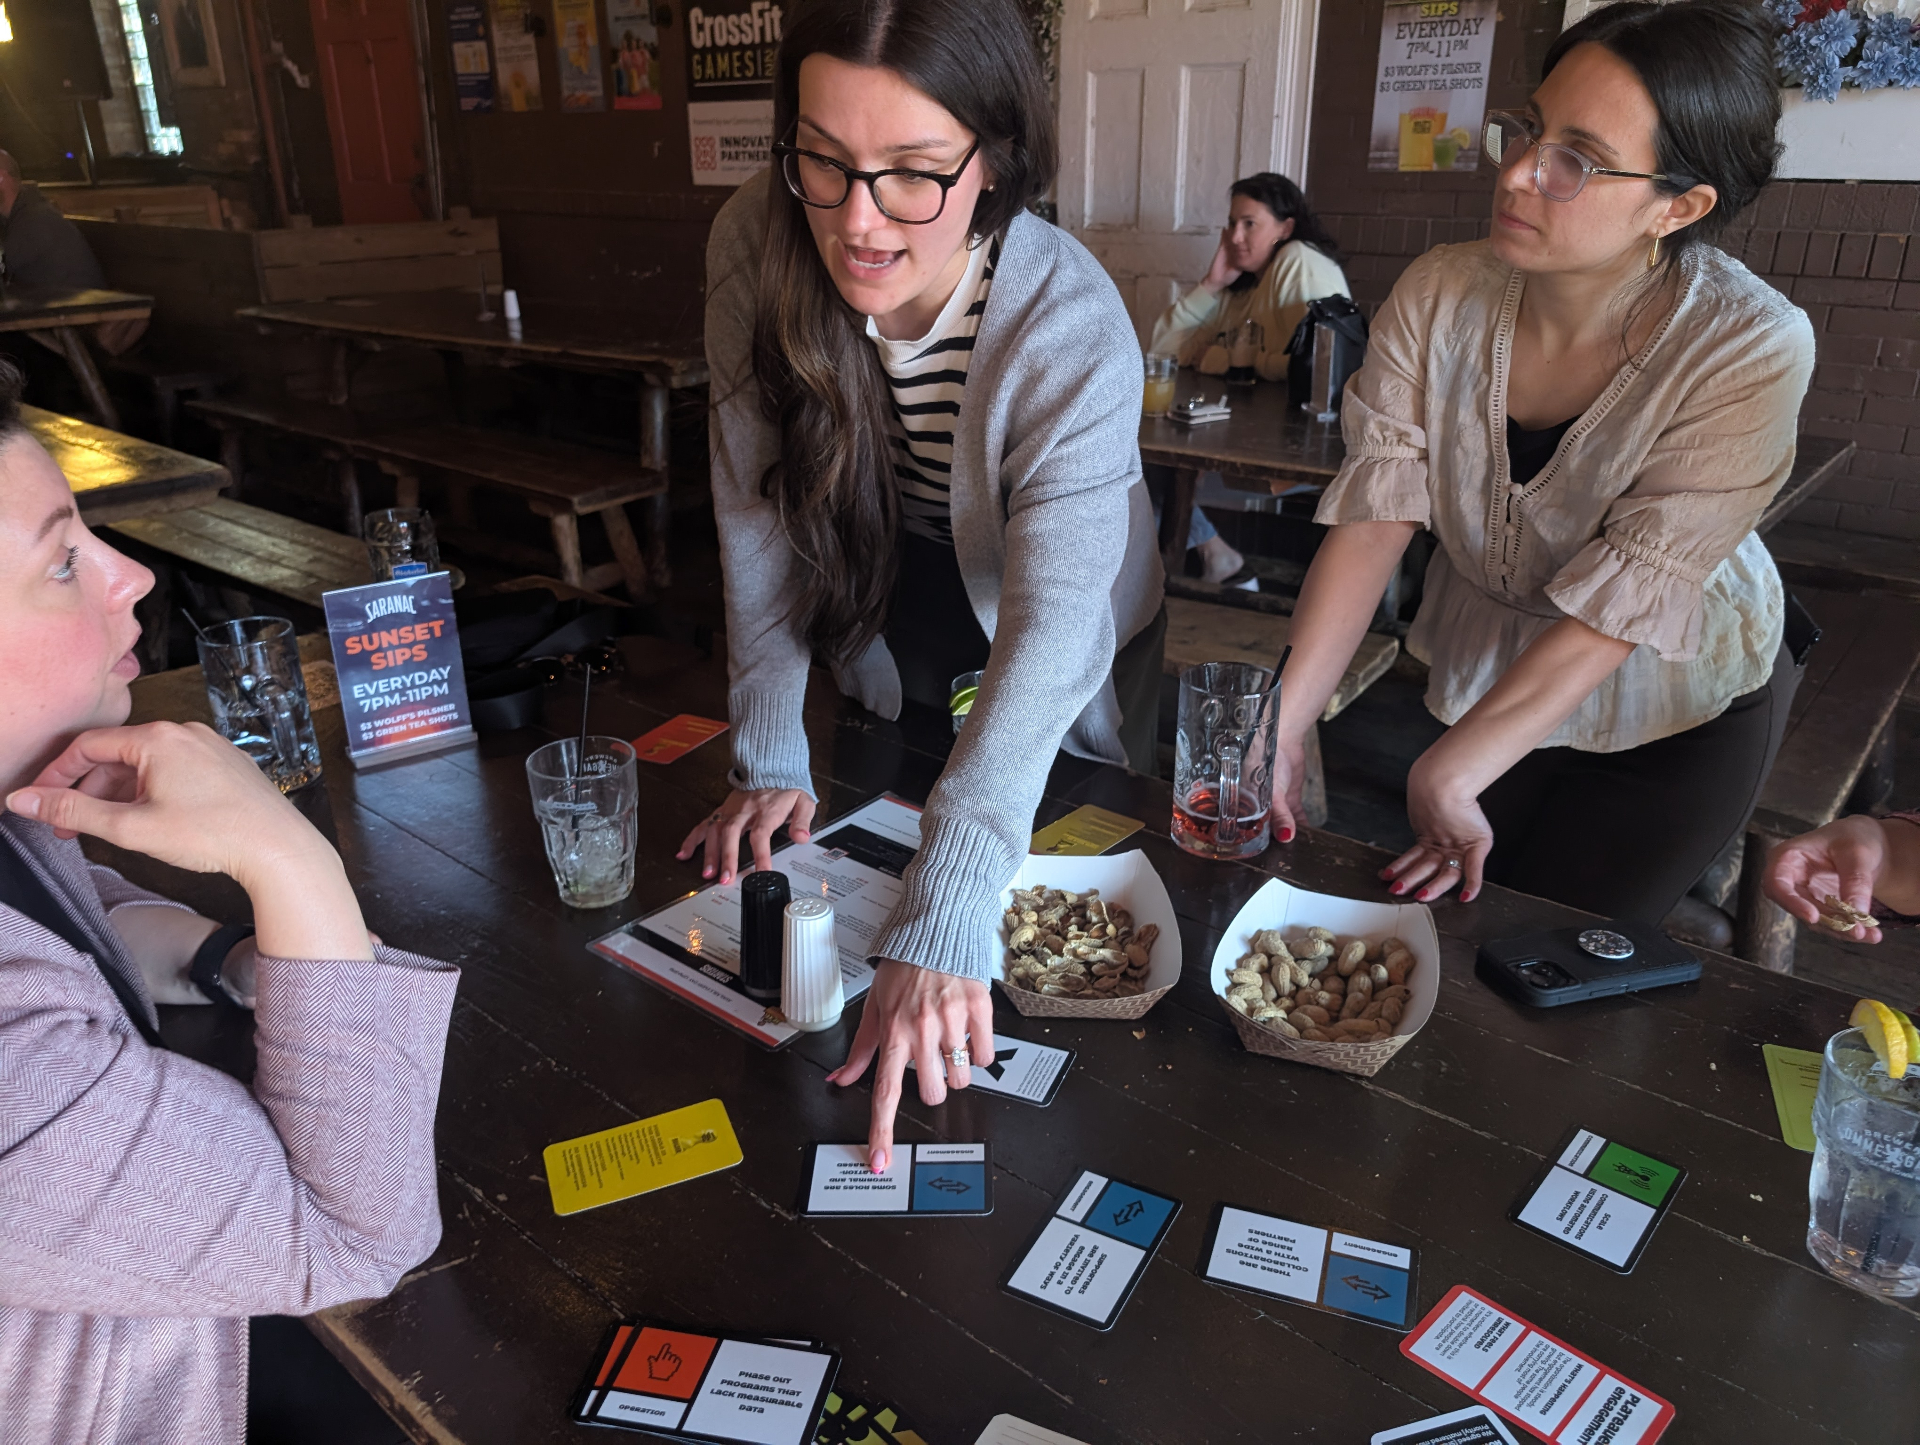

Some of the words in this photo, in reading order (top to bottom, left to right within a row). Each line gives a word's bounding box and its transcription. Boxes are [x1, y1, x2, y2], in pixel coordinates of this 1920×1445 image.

[1420, 2, 1459, 18] SIPS
[689, 1, 783, 49] CrossFit
[1395, 17, 1485, 40] EVERYDAY
[692, 50, 755, 80] GAMES
[1395, 64, 1439, 77] WOLFF'S
[1440, 62, 1482, 75] PILSNER
[1391, 80, 1426, 92] GREEN
[1428, 79, 1448, 91] TEA
[1450, 77, 1484, 90] SHOTS
[364, 594, 417, 623] SARANAC
[345, 620, 444, 655] SUNSET
[370, 643, 428, 670] SIPS
[352, 665, 451, 699] EVERYDAY
[358, 682, 449, 713] 7PM-11PM
[359, 721, 373, 731] $3
[373, 711, 416, 727] WOLFF'S
[416, 703, 456, 718] PILSNER
[361, 730, 374, 741] $3
[374, 723, 407, 737] GREEN
[408, 719, 427, 730] TEA
[428, 712, 459, 725] SHOTS
[699, 964, 734, 984] STARTERS
[1273, 1251, 1300, 1262] WITH
[1053, 1261, 1062, 1271] OF
[1063, 1285, 1074, 1295] TO
[1453, 1320, 1465, 1331] how
[1465, 1309, 1483, 1327] moment
[1440, 1327, 1456, 1344] people
[1449, 1330, 1465, 1345] double
[1439, 1343, 1453, 1357] down
[1534, 1339, 1545, 1349] the
[1526, 1350, 1545, 1369] carrying
[1555, 1351, 1566, 1361] but
[1561, 1356, 1573, 1365] The
[1519, 1367, 1531, 1380] most
[1534, 1365, 1545, 1374] The
[1534, 1359, 1558, 1386] engagement
[1541, 1363, 1565, 1390] organization
[1515, 1377, 1523, 1385] of
[1525, 1372, 1537, 1385] same
[1513, 1382, 1528, 1399] people
[1528, 1384, 1539, 1394] has
[1514, 1392, 1532, 1412] stopped
[1428, 1431, 1462, 1445] mattered
[1456, 1432, 1482, 1444] agreed
[1480, 1429, 1495, 1437] We
